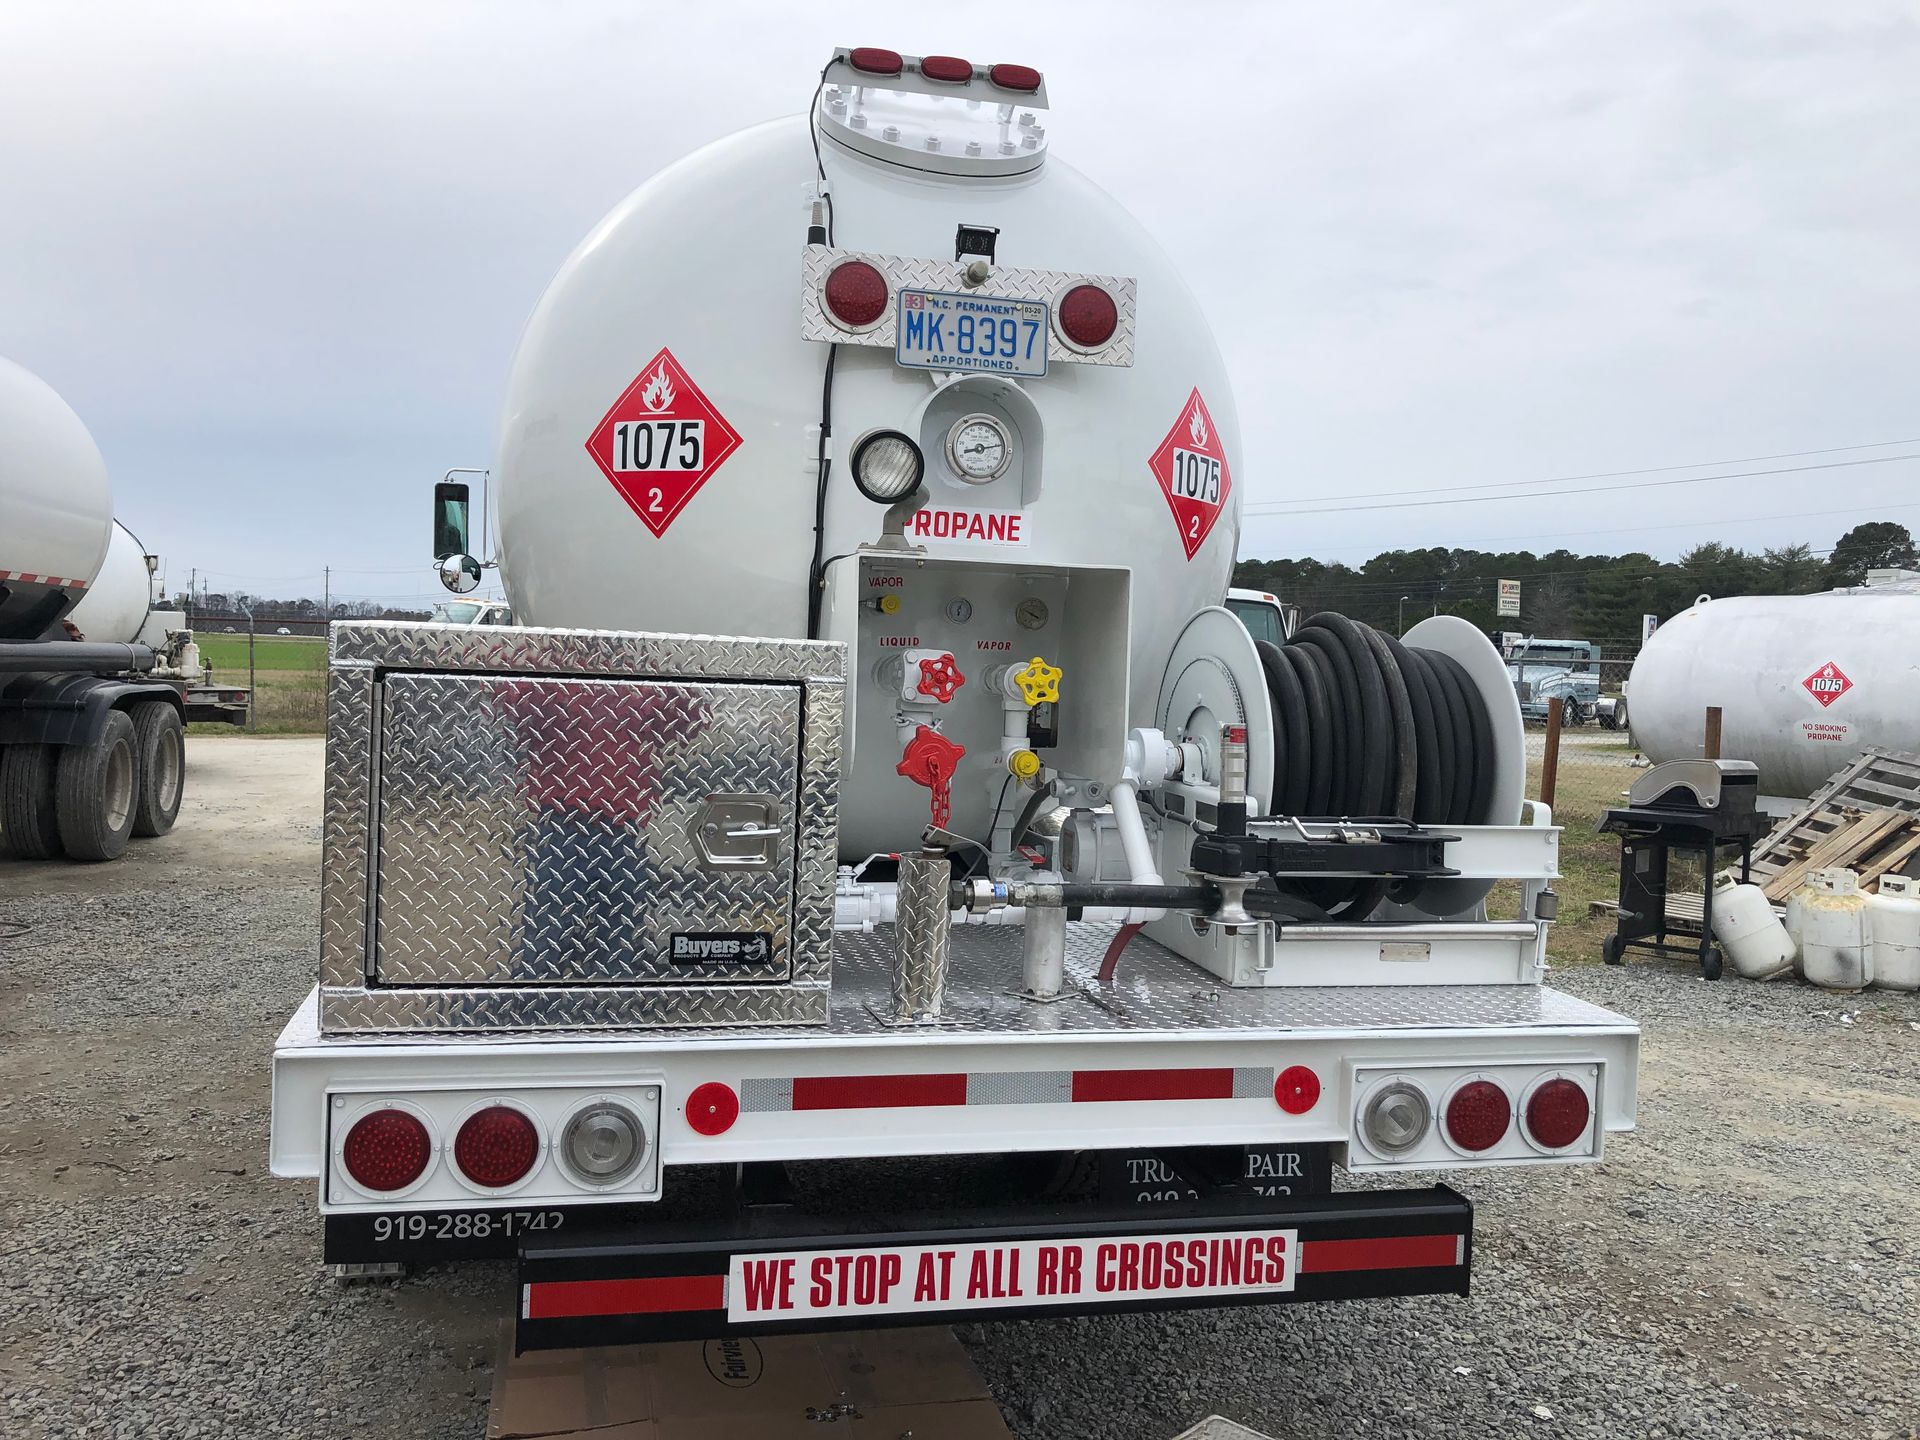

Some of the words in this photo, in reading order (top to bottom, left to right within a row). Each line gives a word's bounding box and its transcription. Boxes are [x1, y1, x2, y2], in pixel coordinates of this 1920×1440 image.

[912, 295, 921, 309] 3
[932, 301, 951, 310] N.C.
[956, 302, 1016, 316] PERMANENT
[1024, 306, 1042, 314] 03-20
[906, 310, 1040, 360] MK-8397
[932, 355, 1013, 370] APPORTIONED
[617, 422, 700, 470] 1075
[1176, 451, 1220, 504] 1075
[648, 487, 663, 512] 2
[1189, 515, 1200, 538] 2
[868, 577, 904, 587] VAPOR
[880, 637, 920, 646] LIQUID
[977, 641, 1011, 650] VAPOR
[1814, 679, 1841, 691] 1075
[1815, 724, 1847, 733] SMOKING
[1807, 733, 1842, 741] PROPANE
[674, 936, 740, 958] Buyers
[743, 1258, 795, 1311] WE
[810, 1254, 901, 1308] STOP
[914, 1251, 955, 1302] AT
[967, 1248, 1023, 1299] ALL
[1037, 1245, 1083, 1296] RR
[1095, 1236, 1286, 1292] CROSSINGS
